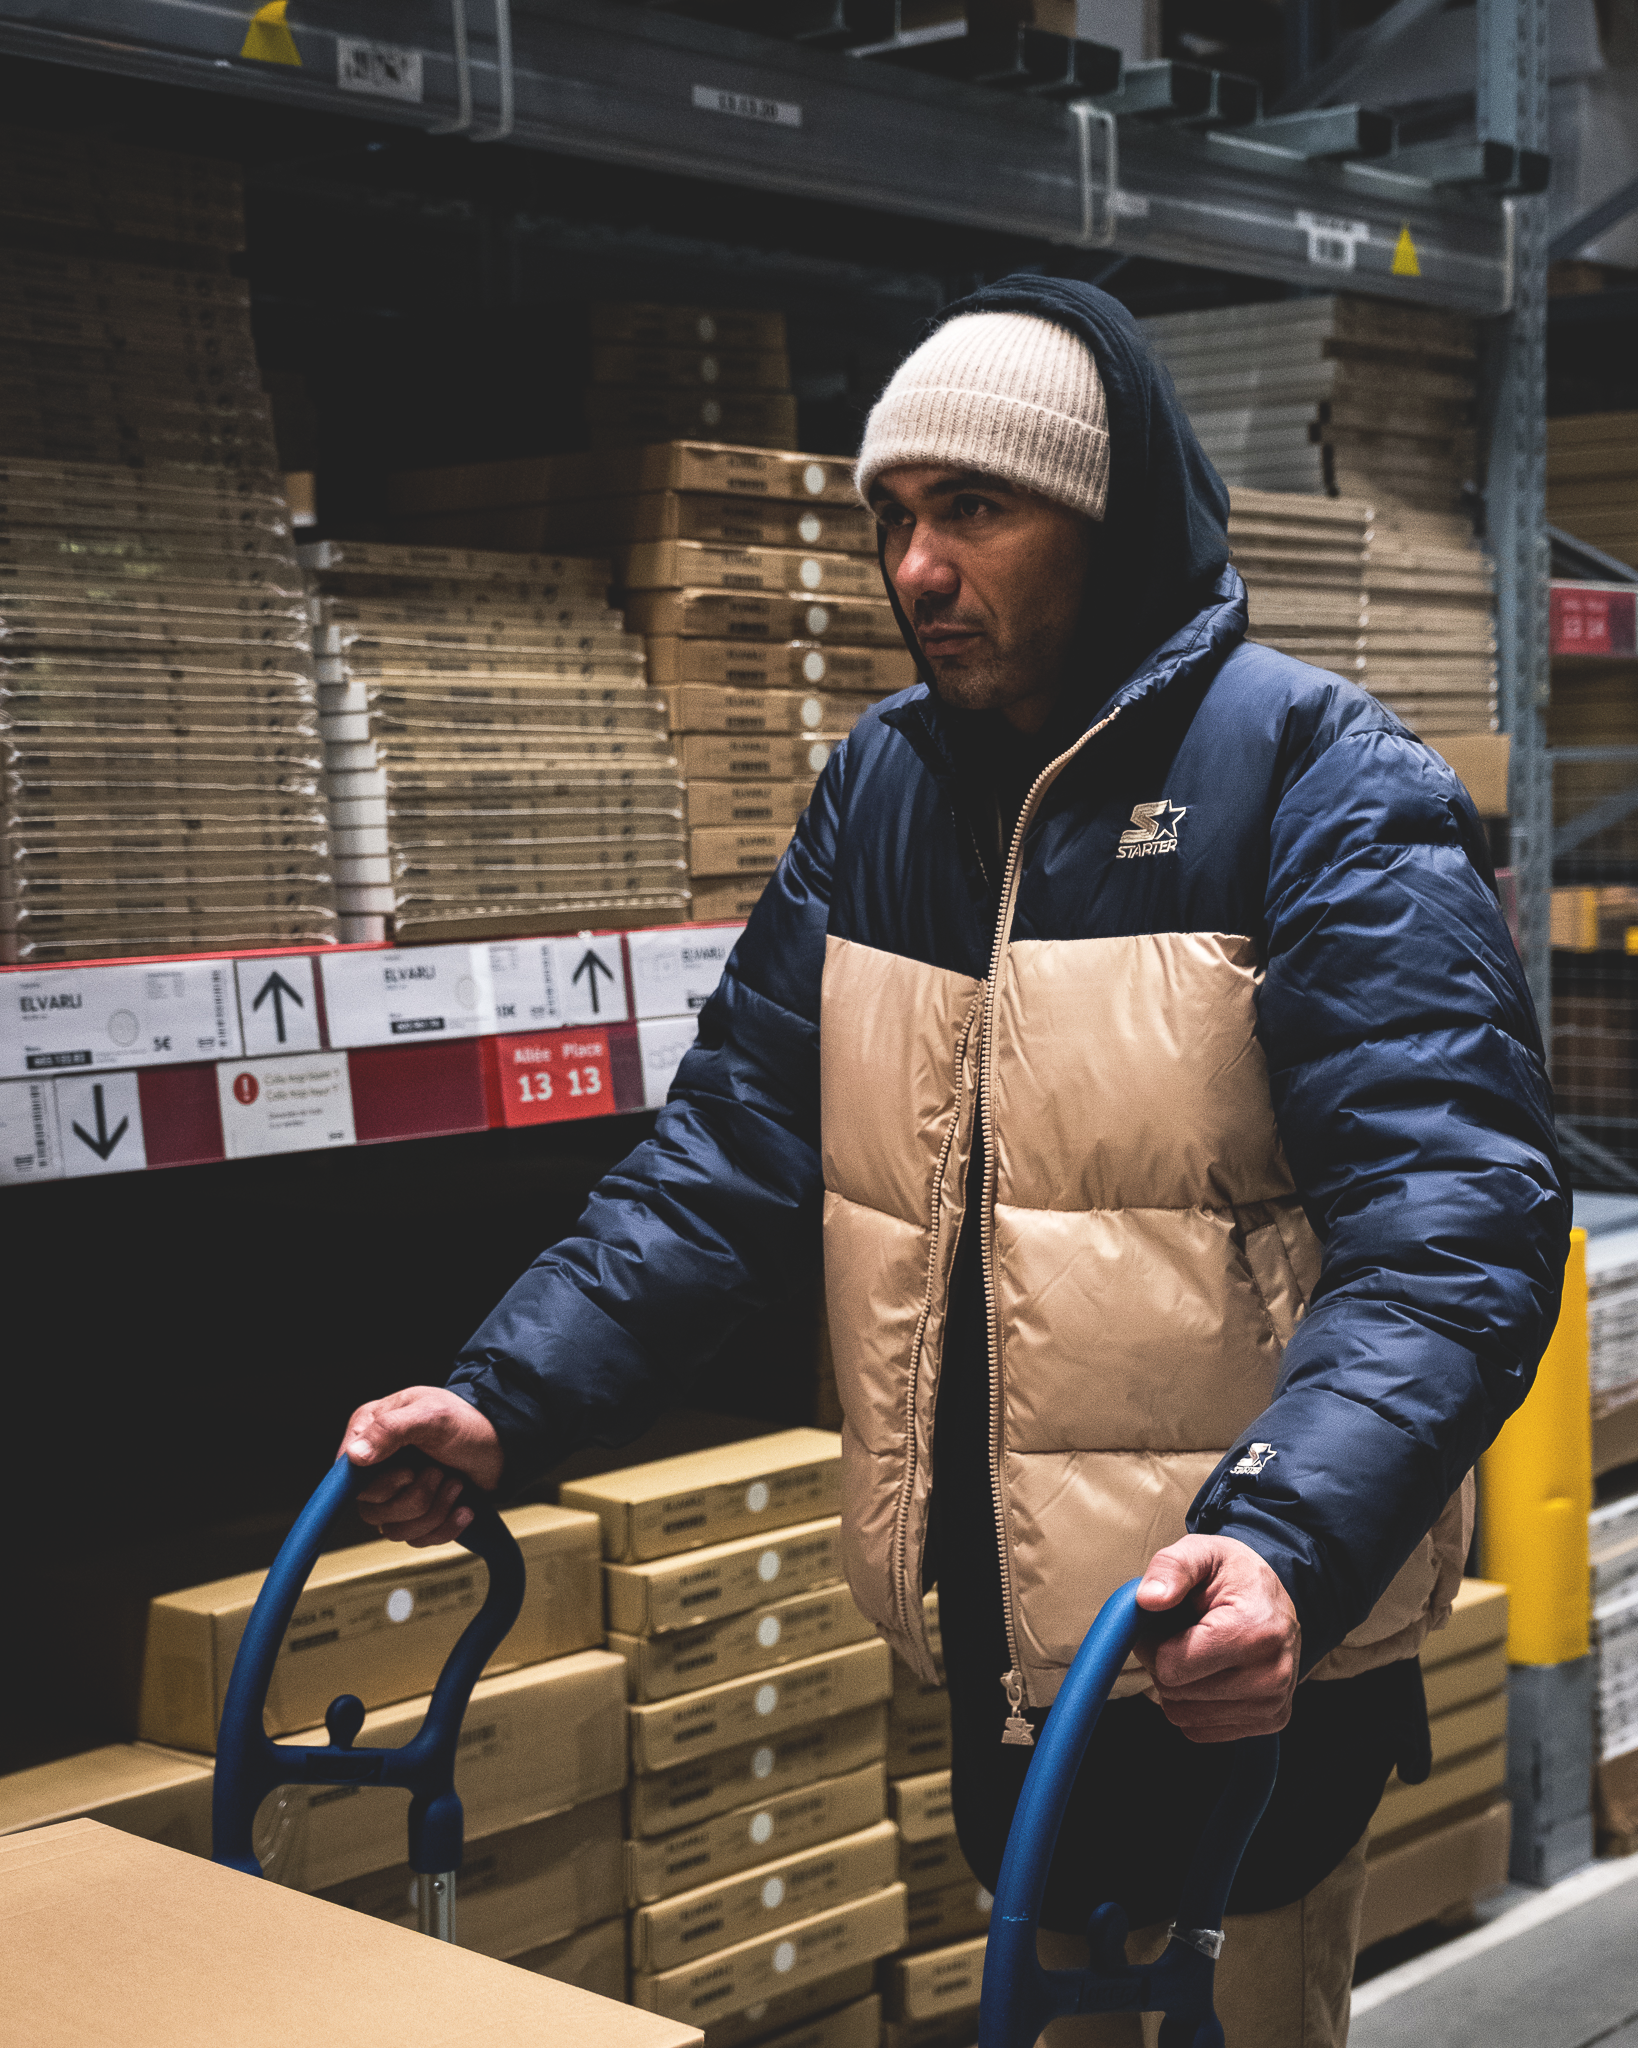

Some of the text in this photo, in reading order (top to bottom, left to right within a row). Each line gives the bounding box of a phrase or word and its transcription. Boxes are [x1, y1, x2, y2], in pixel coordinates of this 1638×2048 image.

[1116, 838, 1178, 859] STARTER
[20, 994, 82, 1012] ELVARLI
[519, 1066, 601, 1102] 13 13
